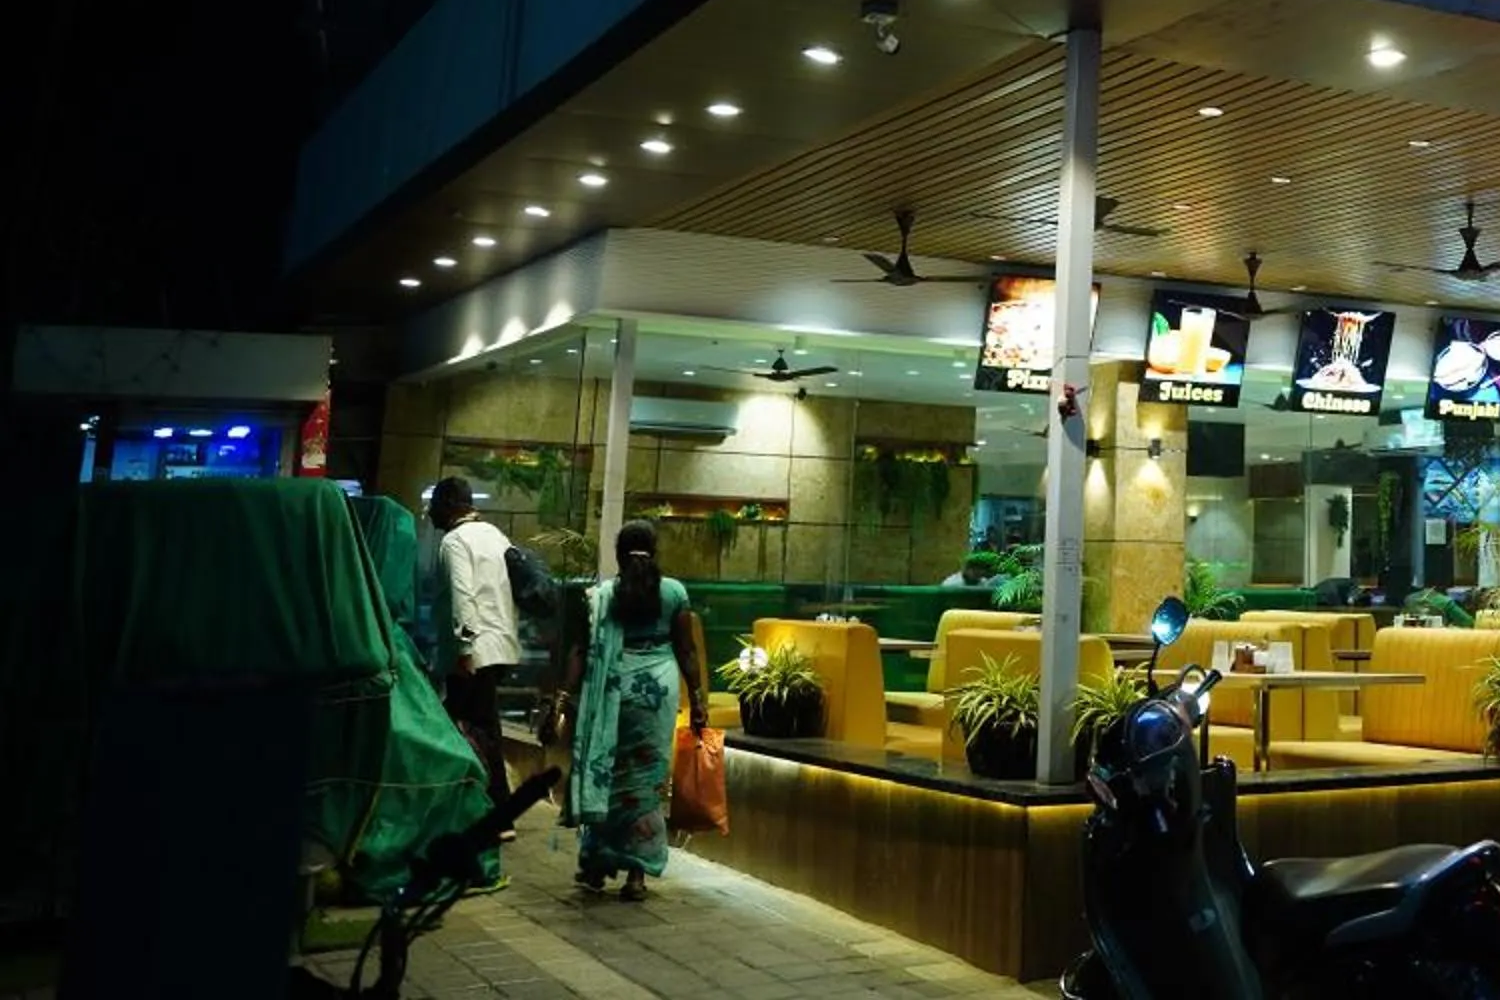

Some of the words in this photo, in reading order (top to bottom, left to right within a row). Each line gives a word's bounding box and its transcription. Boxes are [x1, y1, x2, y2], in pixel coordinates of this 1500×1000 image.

[1007, 368, 1050, 391] Pizz
[1158, 380, 1223, 402] Juices
[1302, 391, 1371, 413] Chinese
[1438, 399, 1500, 421] Punjabi
